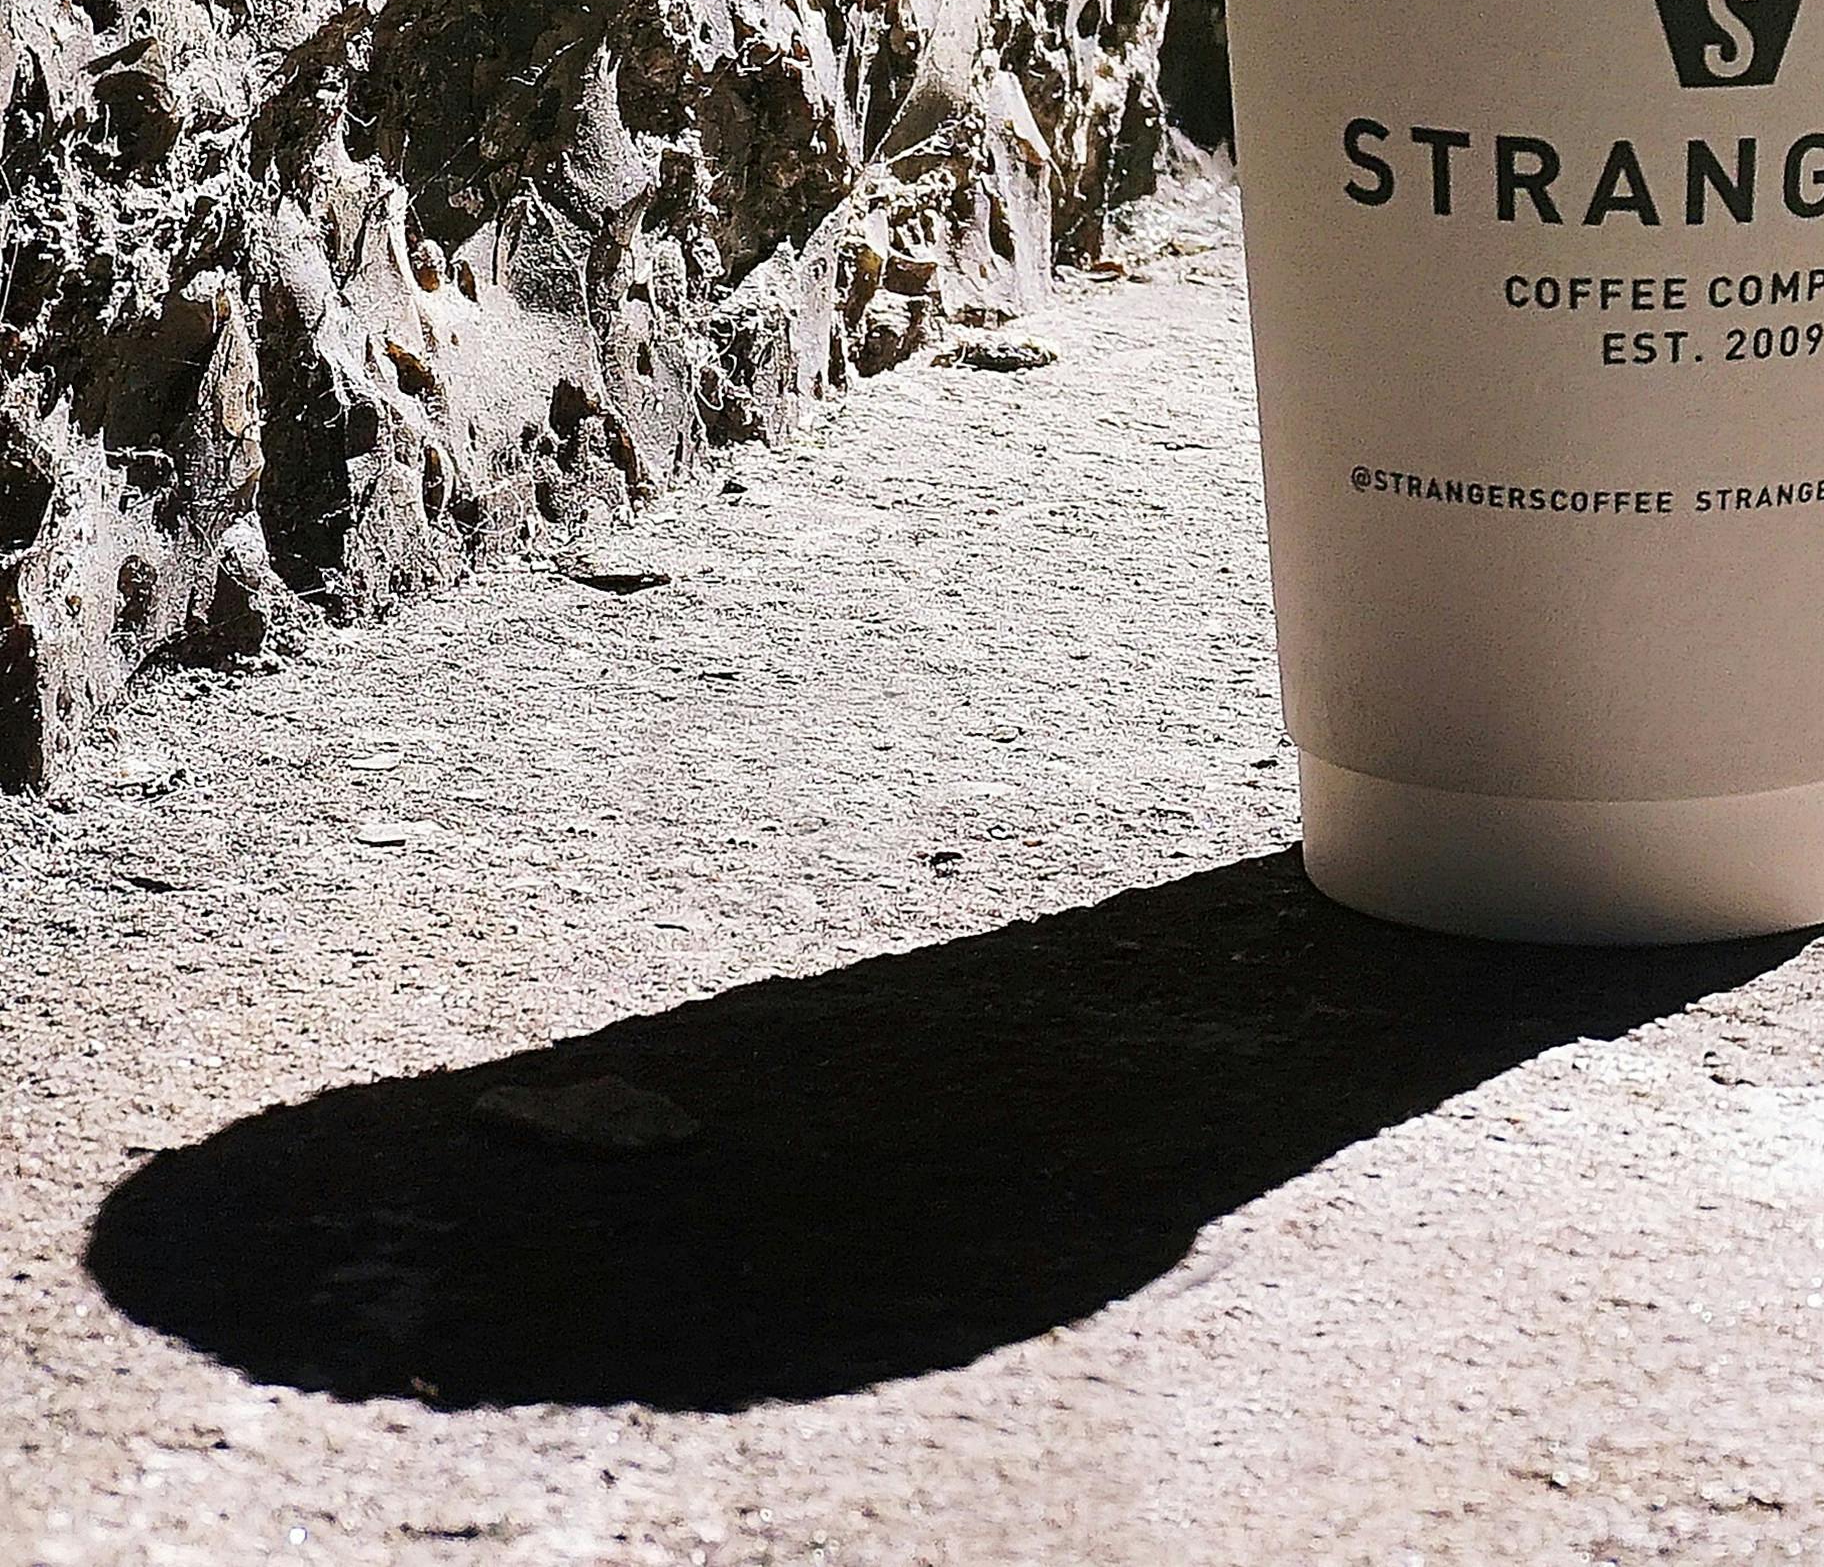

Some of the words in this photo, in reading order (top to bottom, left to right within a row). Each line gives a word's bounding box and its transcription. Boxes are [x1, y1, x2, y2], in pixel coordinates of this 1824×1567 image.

[1503, 274, 1688, 311] COFFEE
[1602, 331, 1703, 366] EST.
[1725, 323, 1824, 361] 2009
[1350, 465, 1674, 514] @STRANGERSCOFFEE
